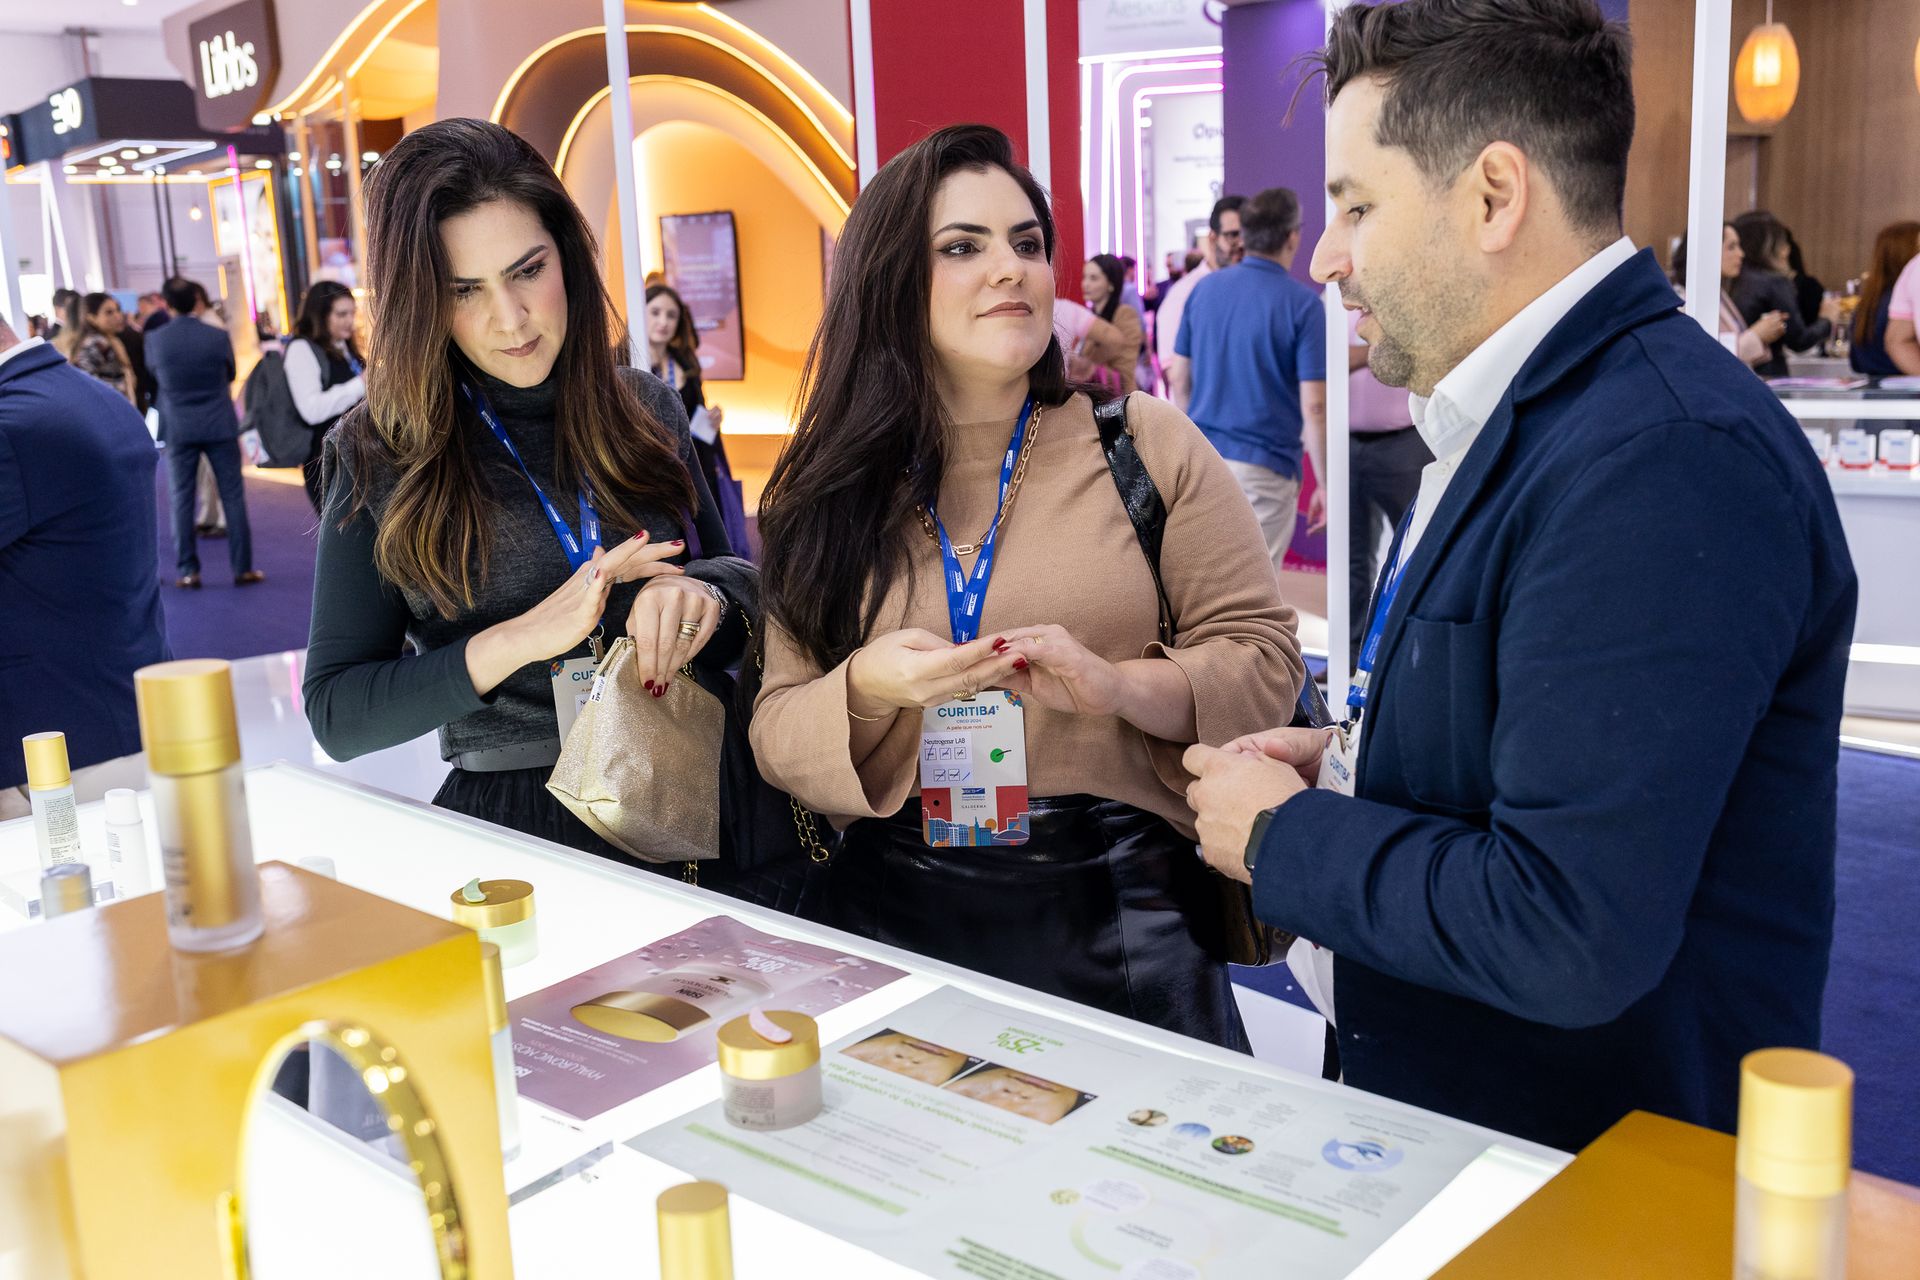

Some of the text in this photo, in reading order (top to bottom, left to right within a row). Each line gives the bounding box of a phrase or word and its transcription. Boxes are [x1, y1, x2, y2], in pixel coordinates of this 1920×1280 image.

[200, 31, 259, 98] Libbs
[938, 706, 996, 718] CURITIBA
[676, 989, 704, 999] ISDIN
[534, 1052, 606, 1080] HYALURONIC
